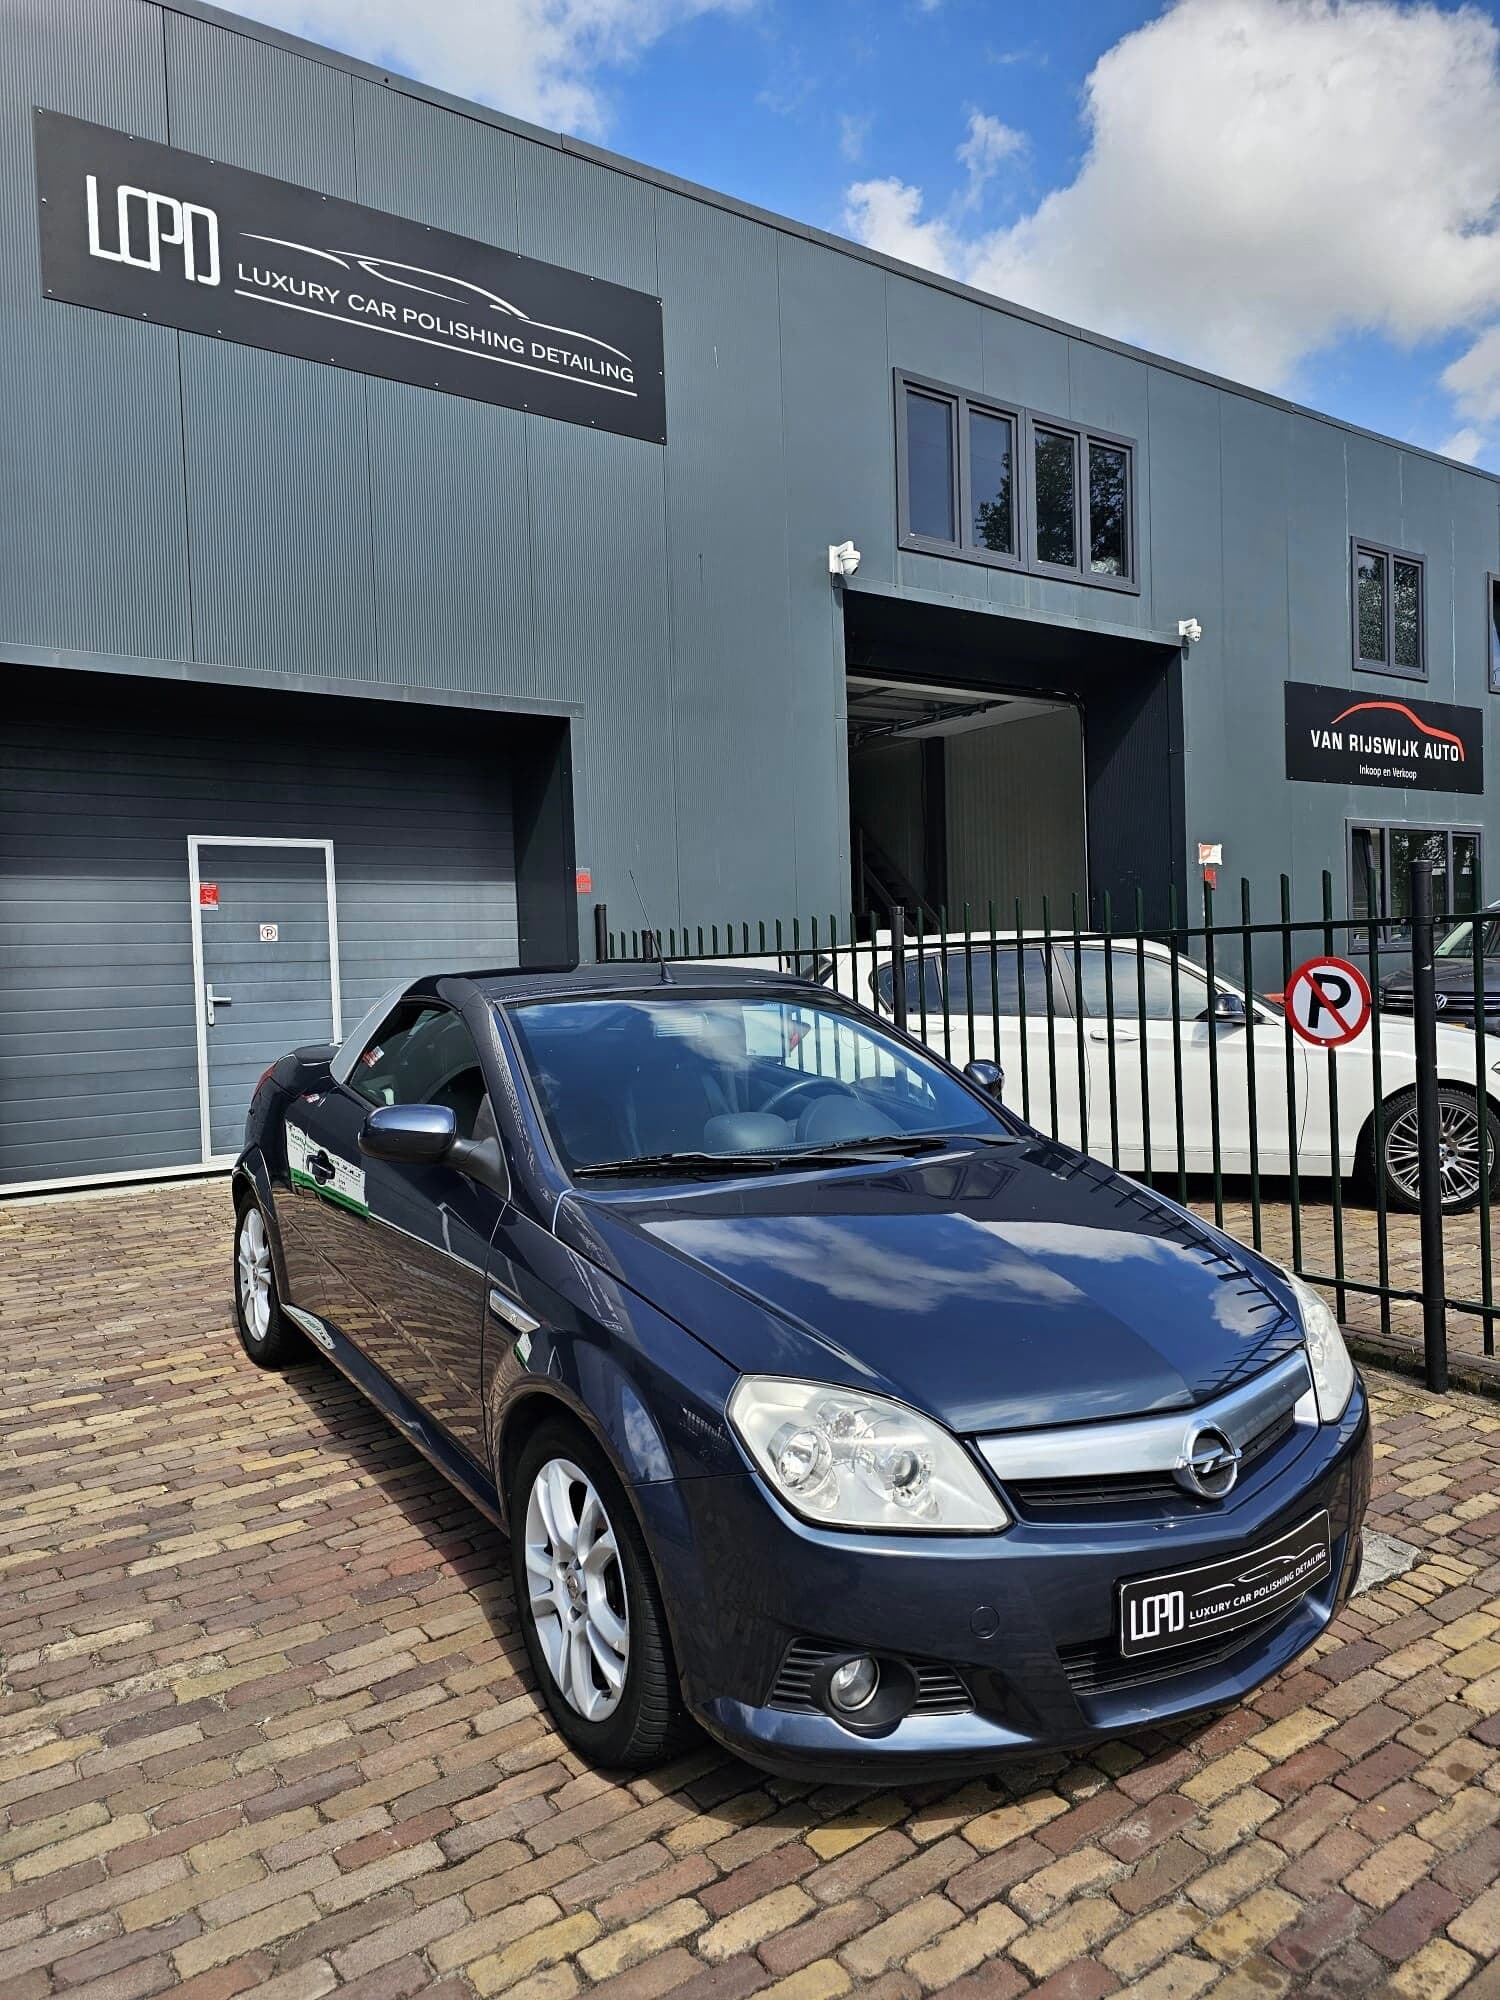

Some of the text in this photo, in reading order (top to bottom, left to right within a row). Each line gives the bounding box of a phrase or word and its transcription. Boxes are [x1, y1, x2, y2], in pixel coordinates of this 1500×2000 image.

[238, 262, 635, 384] LUXURY CAR POLISHING DETAILING
[1311, 729, 1459, 762] VAN RIJSWIJK AUTO
[1359, 764, 1417, 780] Inkoop en Verkoop
[1189, 1548, 1327, 1620] LUXURY CAR POLISHING DETAILING
